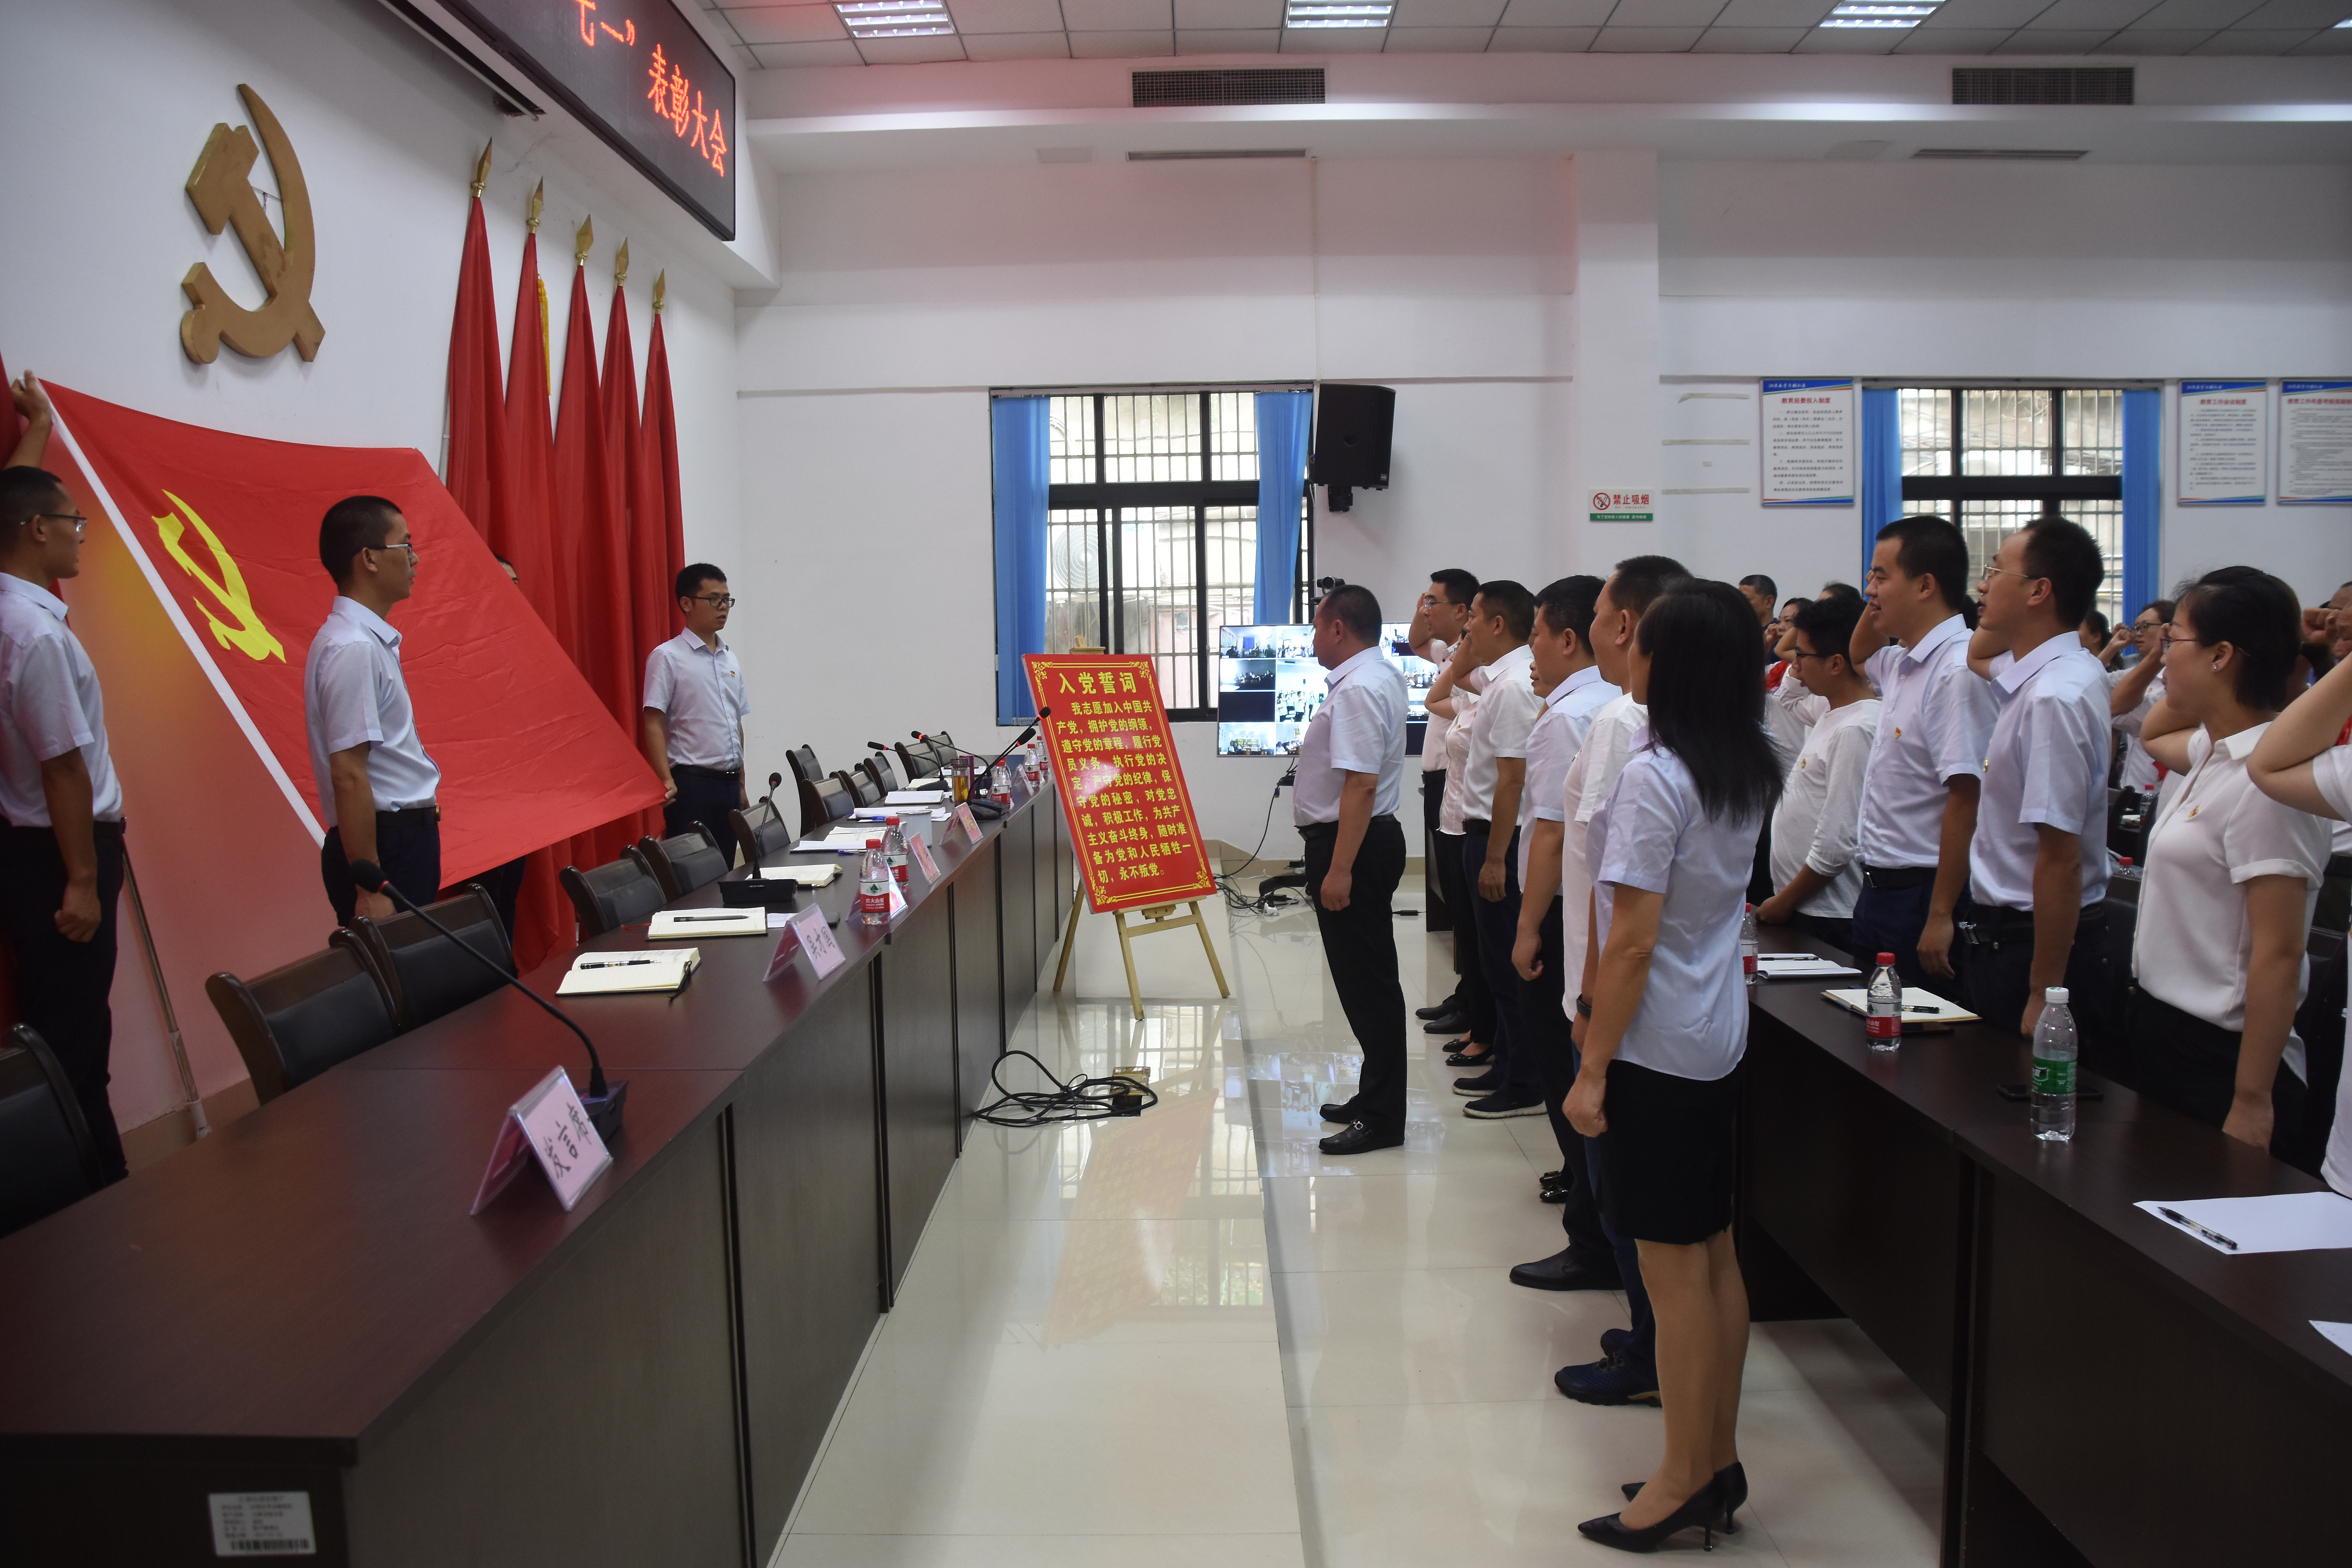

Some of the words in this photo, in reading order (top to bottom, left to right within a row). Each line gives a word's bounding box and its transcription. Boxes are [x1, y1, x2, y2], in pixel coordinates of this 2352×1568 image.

[647, 44, 727, 177] 表彰大会
[1613, 494, 1649, 505] 禁止吸烟
[1059, 672, 1137, 694] 入党誓词
[1071, 700, 1152, 715] 我志愿加入中国共
[1093, 841, 1191, 865] 备为党和人民牺牲一
